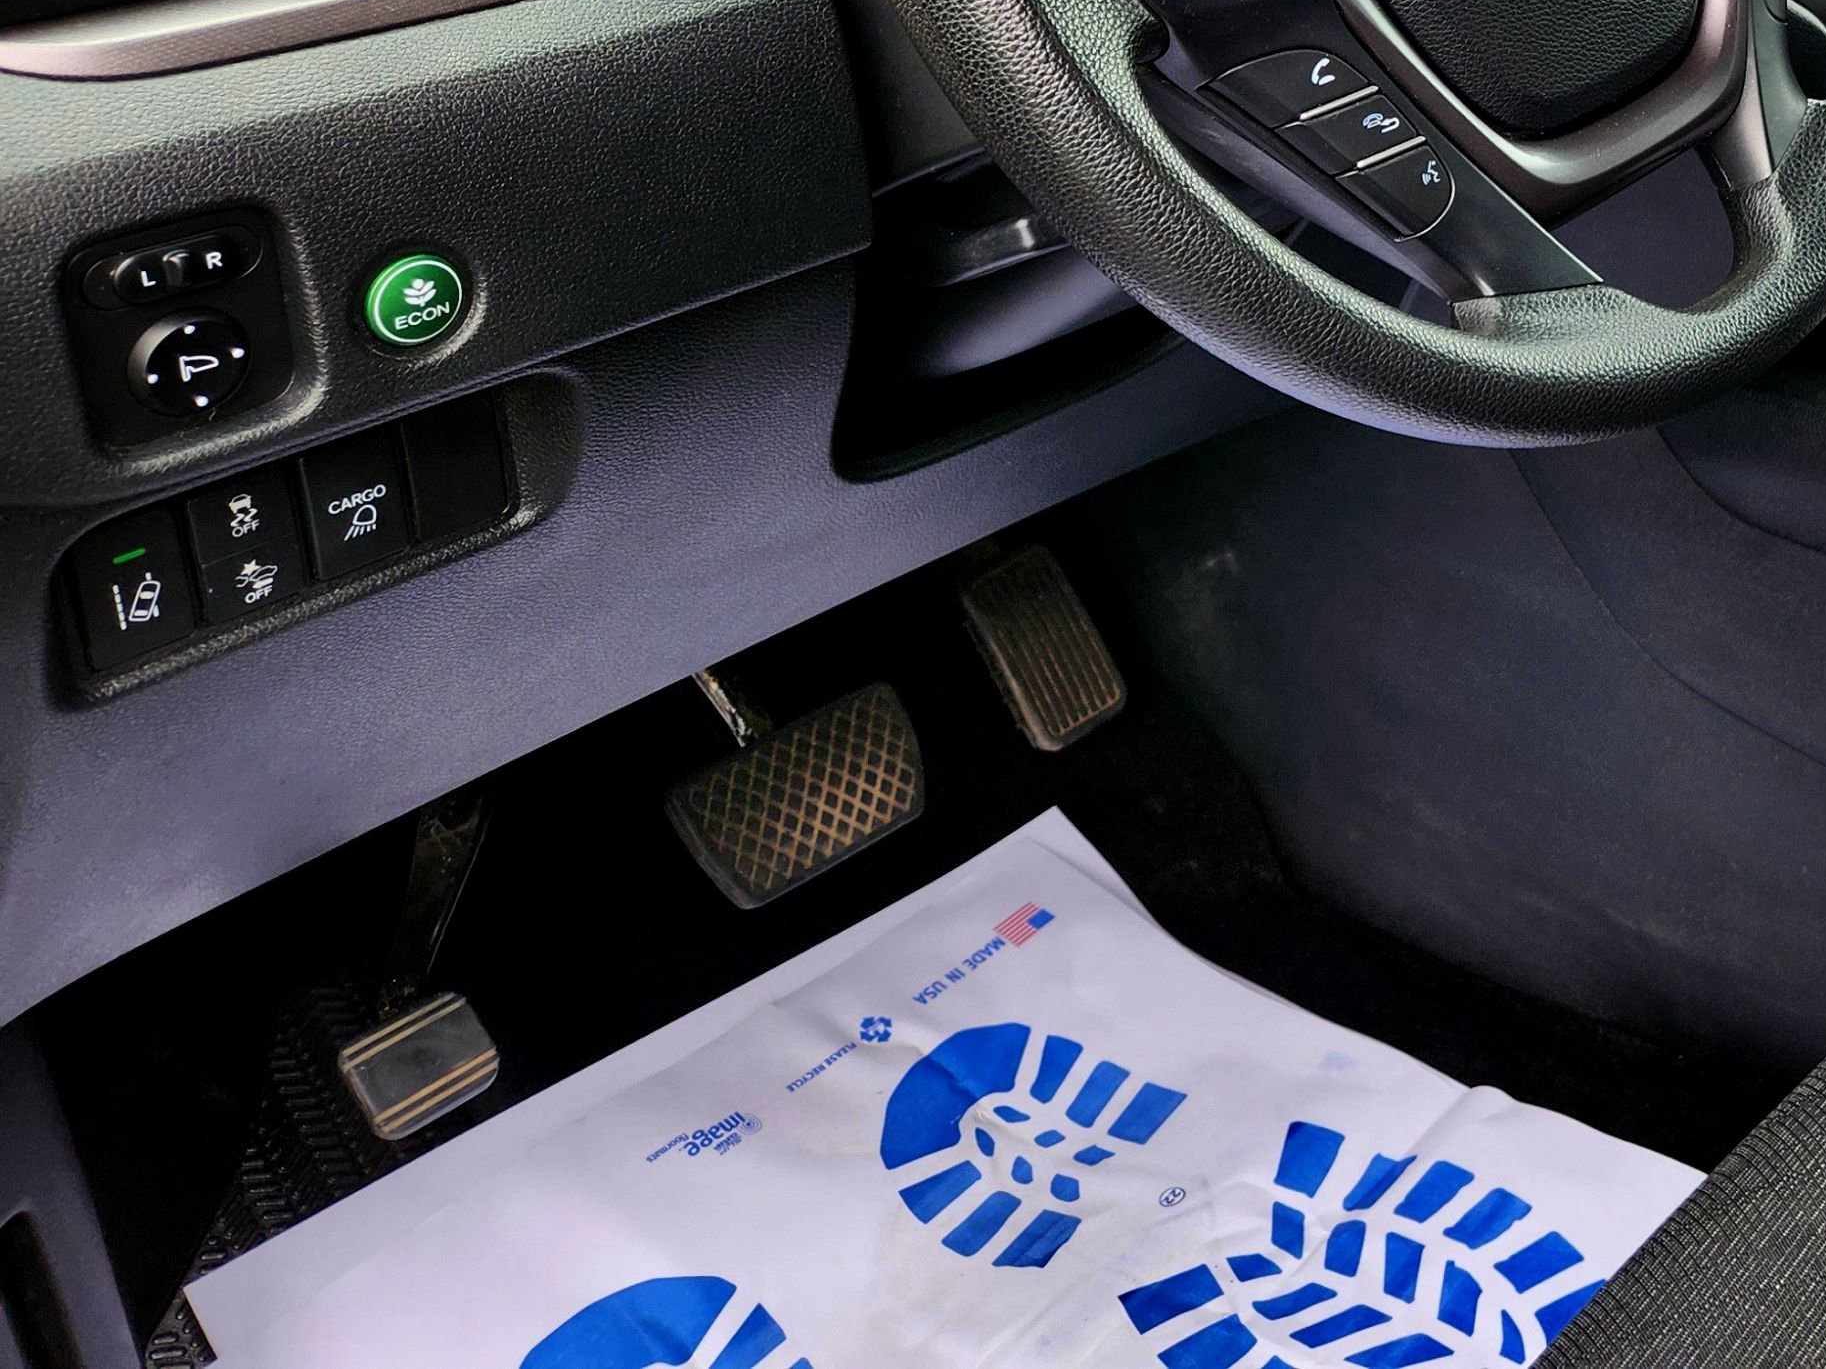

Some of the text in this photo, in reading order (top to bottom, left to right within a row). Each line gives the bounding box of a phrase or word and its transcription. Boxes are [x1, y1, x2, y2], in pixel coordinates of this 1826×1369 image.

[205, 251, 223, 270] R
[140, 270, 157, 288] L
[394, 301, 450, 331] ECON
[328, 484, 387, 515] CARGO
[232, 518, 260, 538] OFF
[244, 584, 273, 604] OFF
[912, 936, 1006, 1005] MADE IN USA
[786, 1041, 858, 1093] PLEASE RECYCLE
[683, 1111, 746, 1157] image
